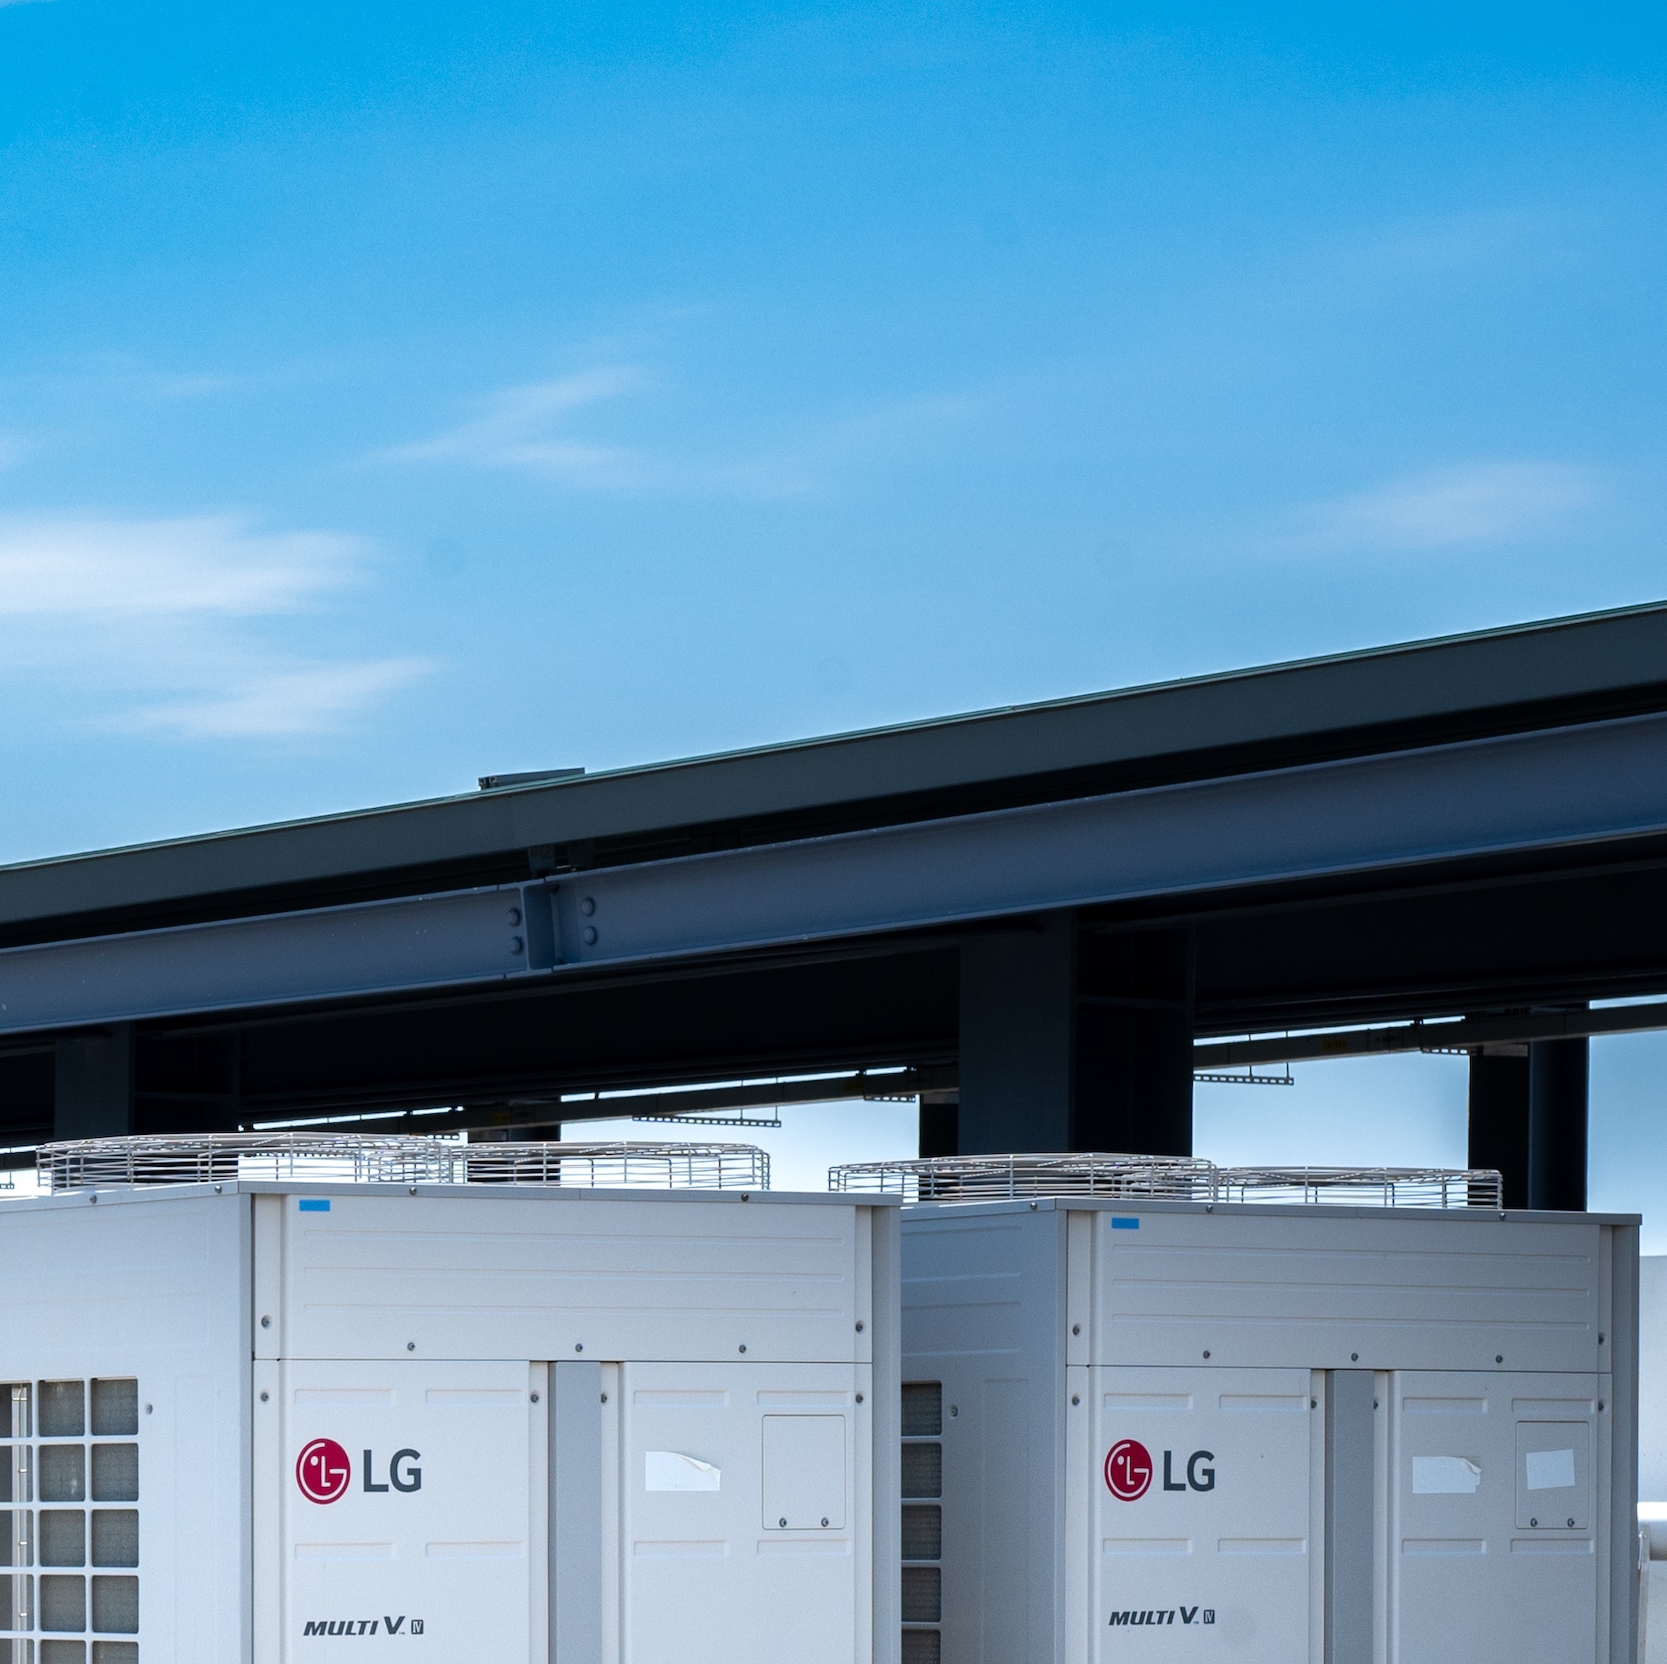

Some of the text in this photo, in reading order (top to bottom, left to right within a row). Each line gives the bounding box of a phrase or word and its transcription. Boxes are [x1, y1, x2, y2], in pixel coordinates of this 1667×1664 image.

[363, 1448, 422, 1493] LG
[1163, 1449, 1216, 1493] LG
[303, 1620, 379, 1637] MULTI
[1108, 1610, 1176, 1626] MULTI
